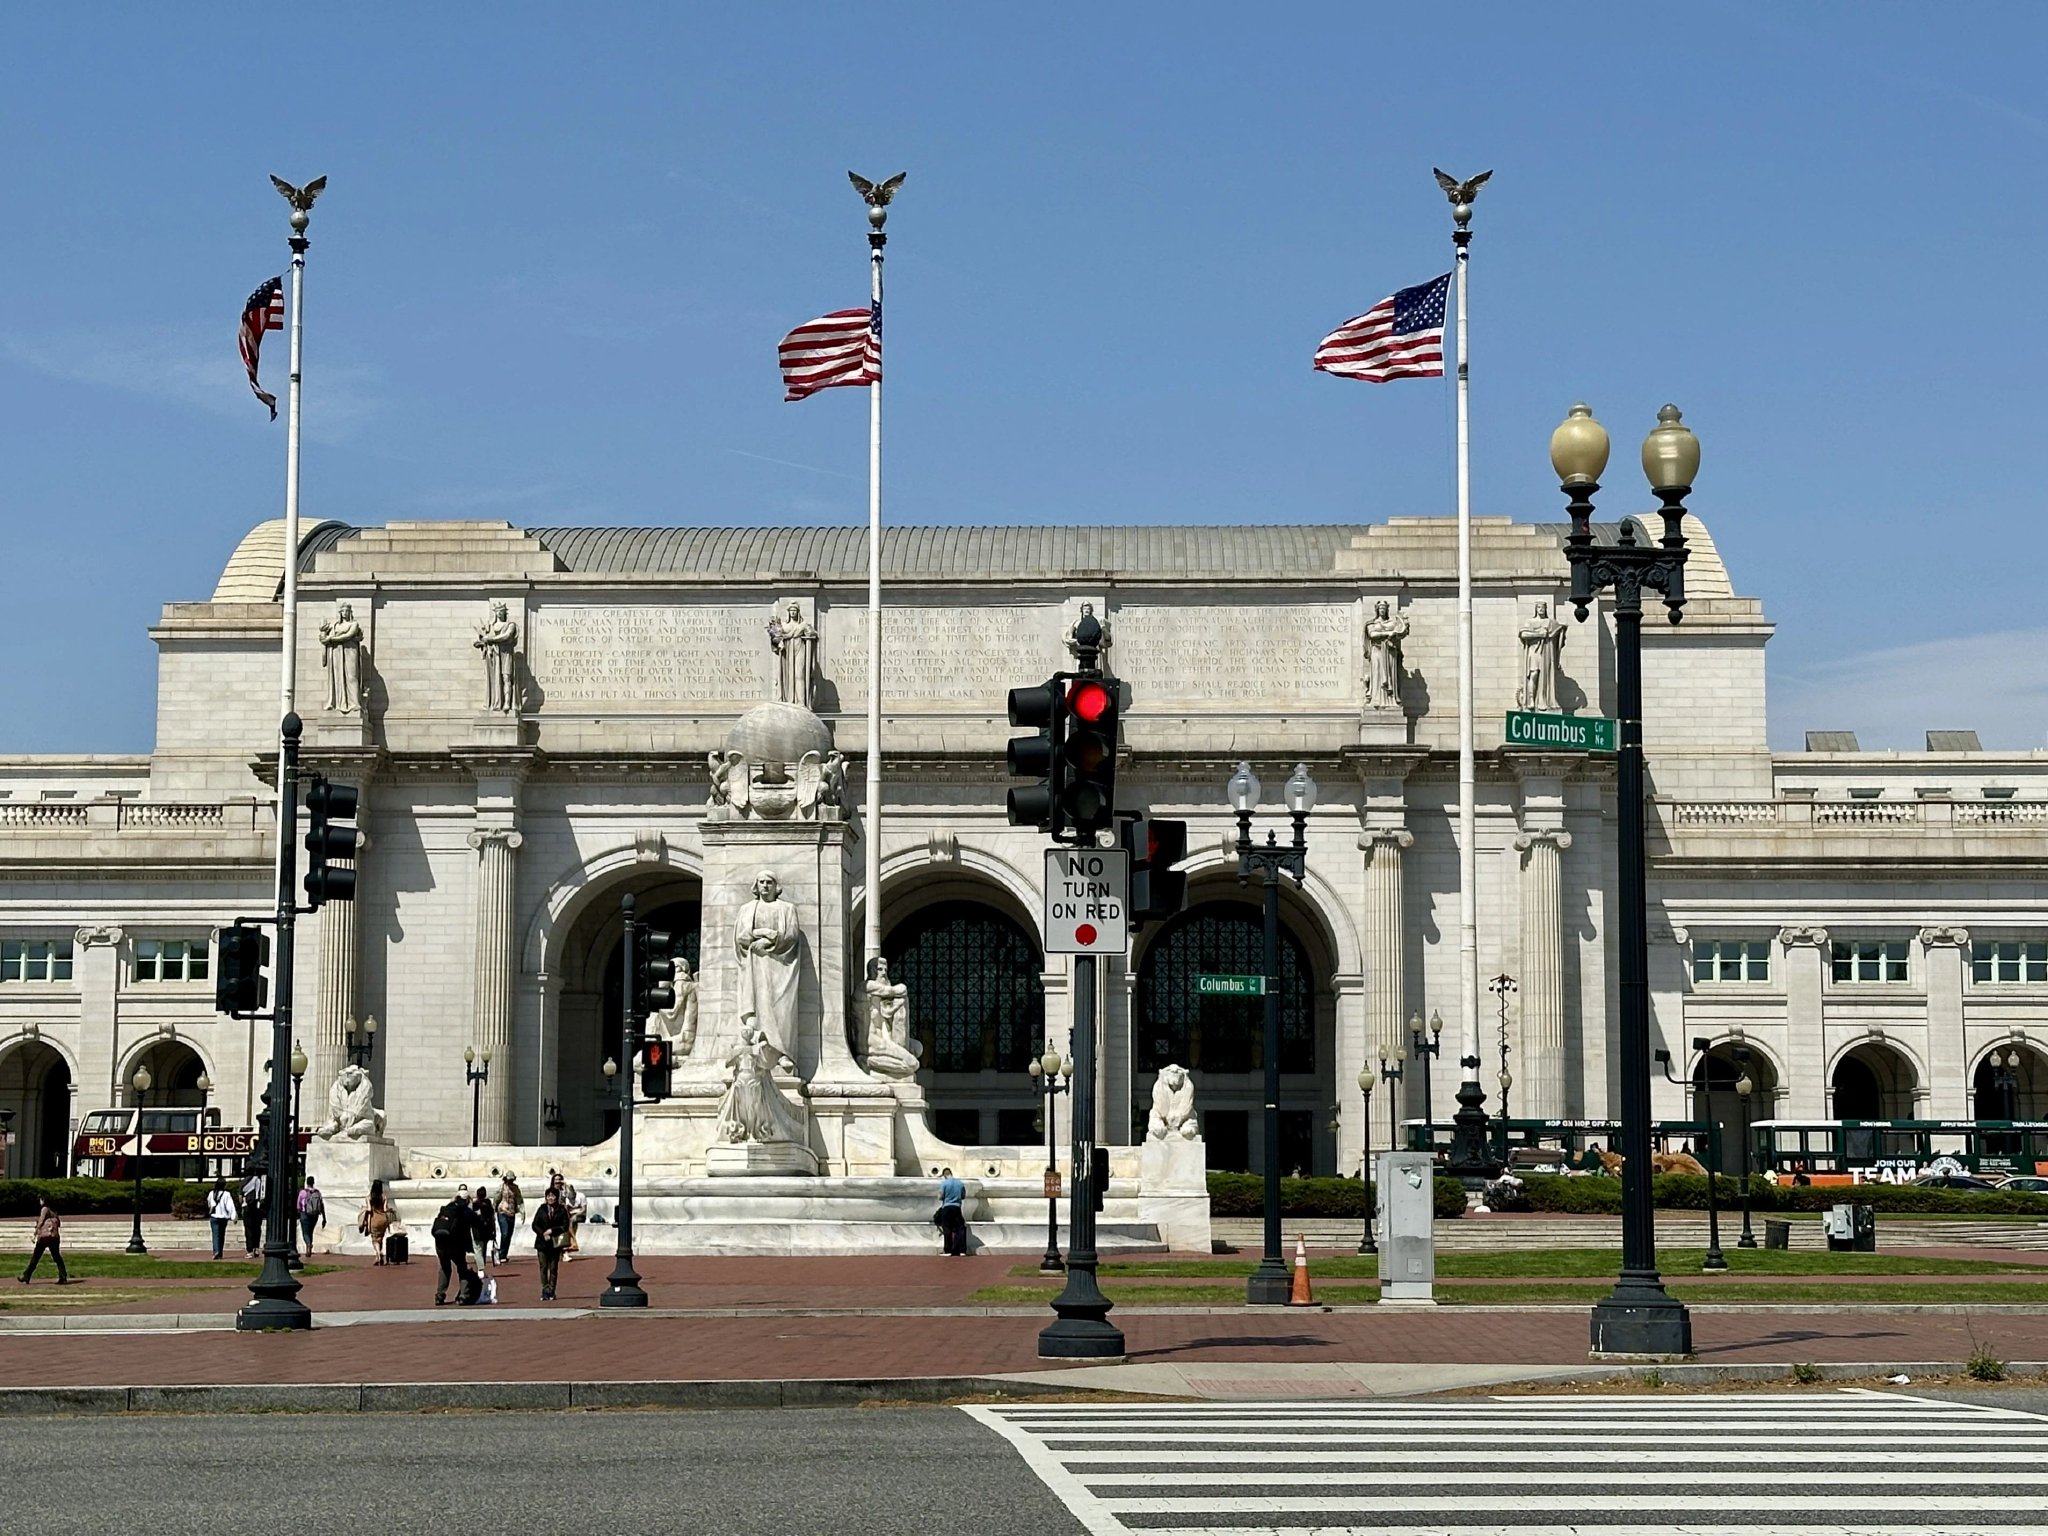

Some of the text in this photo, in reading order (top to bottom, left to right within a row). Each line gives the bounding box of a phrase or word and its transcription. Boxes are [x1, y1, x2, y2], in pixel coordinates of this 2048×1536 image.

[1512, 715, 1585, 743] Columbus
[1069, 857, 1103, 876] NO
[1063, 882, 1110, 898] TURN
[1052, 903, 1120, 919] ON RED
[1200, 977, 1244, 991] Columbus
[1848, 1168, 1916, 1185] TEAM
